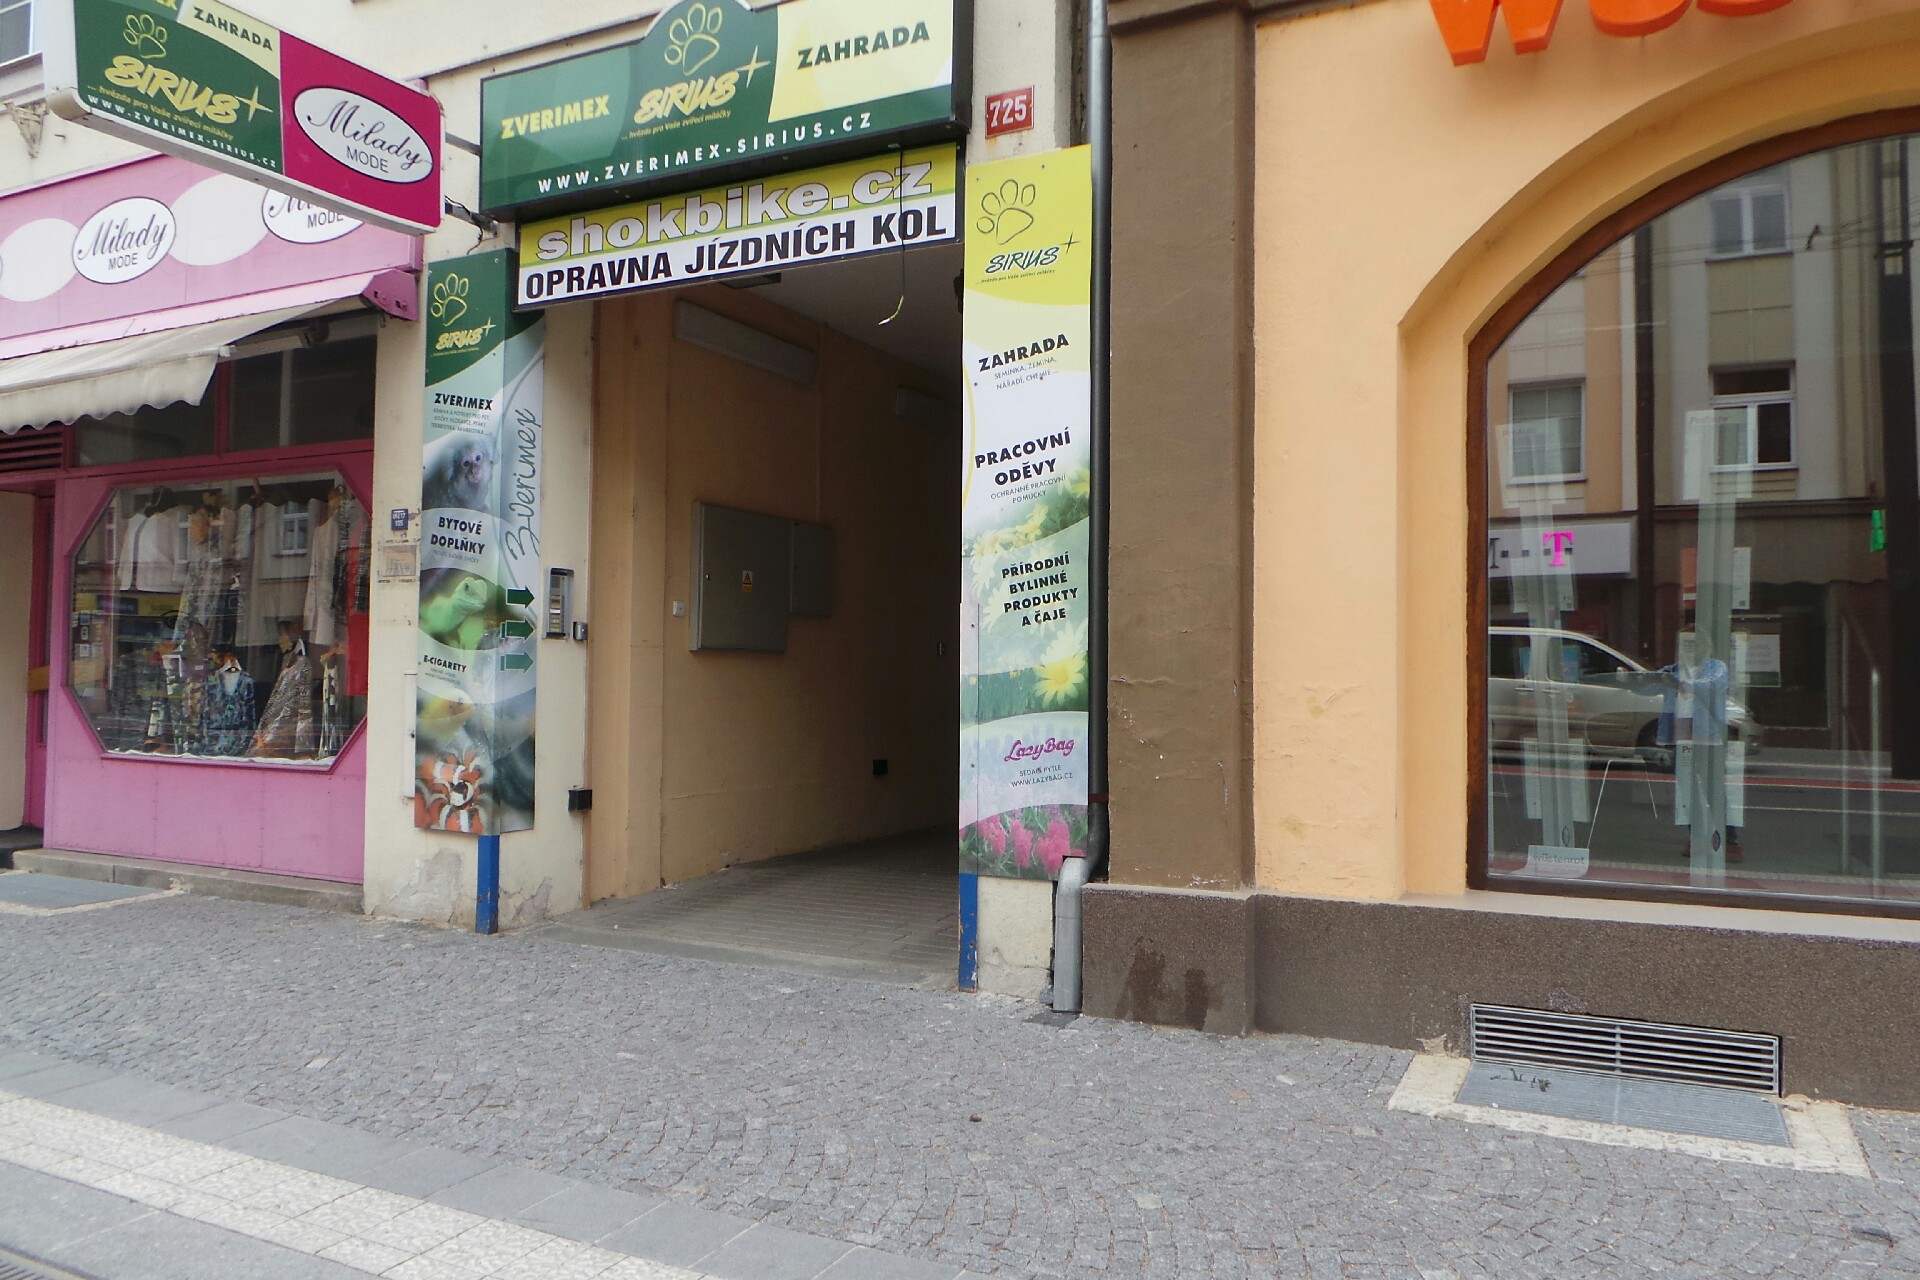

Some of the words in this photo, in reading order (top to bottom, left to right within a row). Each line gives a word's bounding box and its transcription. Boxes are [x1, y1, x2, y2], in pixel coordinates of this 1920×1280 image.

[193, 6, 273, 51] ZAHRADA
[797, 21, 931, 70] ZAHRADA
[104, 55, 241, 124] SIRIUS
[633, 70, 740, 124] SIRIUS
[501, 95, 610, 140] ZVERIMEX
[988, 96, 1028, 129] 725
[87, 94, 277, 167] WWW.ZVERIMEX-SIRIUS.CZ
[306, 100, 434, 168] Milady
[346, 146, 389, 173] MODE
[537, 112, 872, 193] WWW.ZVERIMEX-SIRIUS.CZ
[536, 160, 933, 262] shokbike.cz
[77, 213, 167, 260] Milady
[108, 252, 139, 271] MODE
[525, 251, 673, 302] OPRAVNA
[684, 219, 856, 276] JÍZDNÍCH
[872, 205, 947, 251] KOL
[985, 246, 1060, 274] SIRIUS
[978, 333, 1070, 373] ZAHRADA
[434, 392, 493, 411] ZVERIMEX
[974, 427, 1071, 469] PRACOVNÍ
[994, 458, 1057, 486] ODĚVY
[438, 516, 483, 536] BYTOVÉ
[430, 533, 486, 555] DOPLŇKY
[1001, 551, 1070, 579] PŘÍRODNÍ
[1009, 569, 1068, 595] BYLINNÉ
[1004, 587, 1078, 613] PRODUKTY
[1021, 615, 1031, 627] A
[1034, 607, 1067, 625] ČAJE
[423, 655, 467, 673] E-CIGARETY
[1004, 737, 1075, 762] LazyBag
[1533, 852, 1586, 865] wüstenrot
